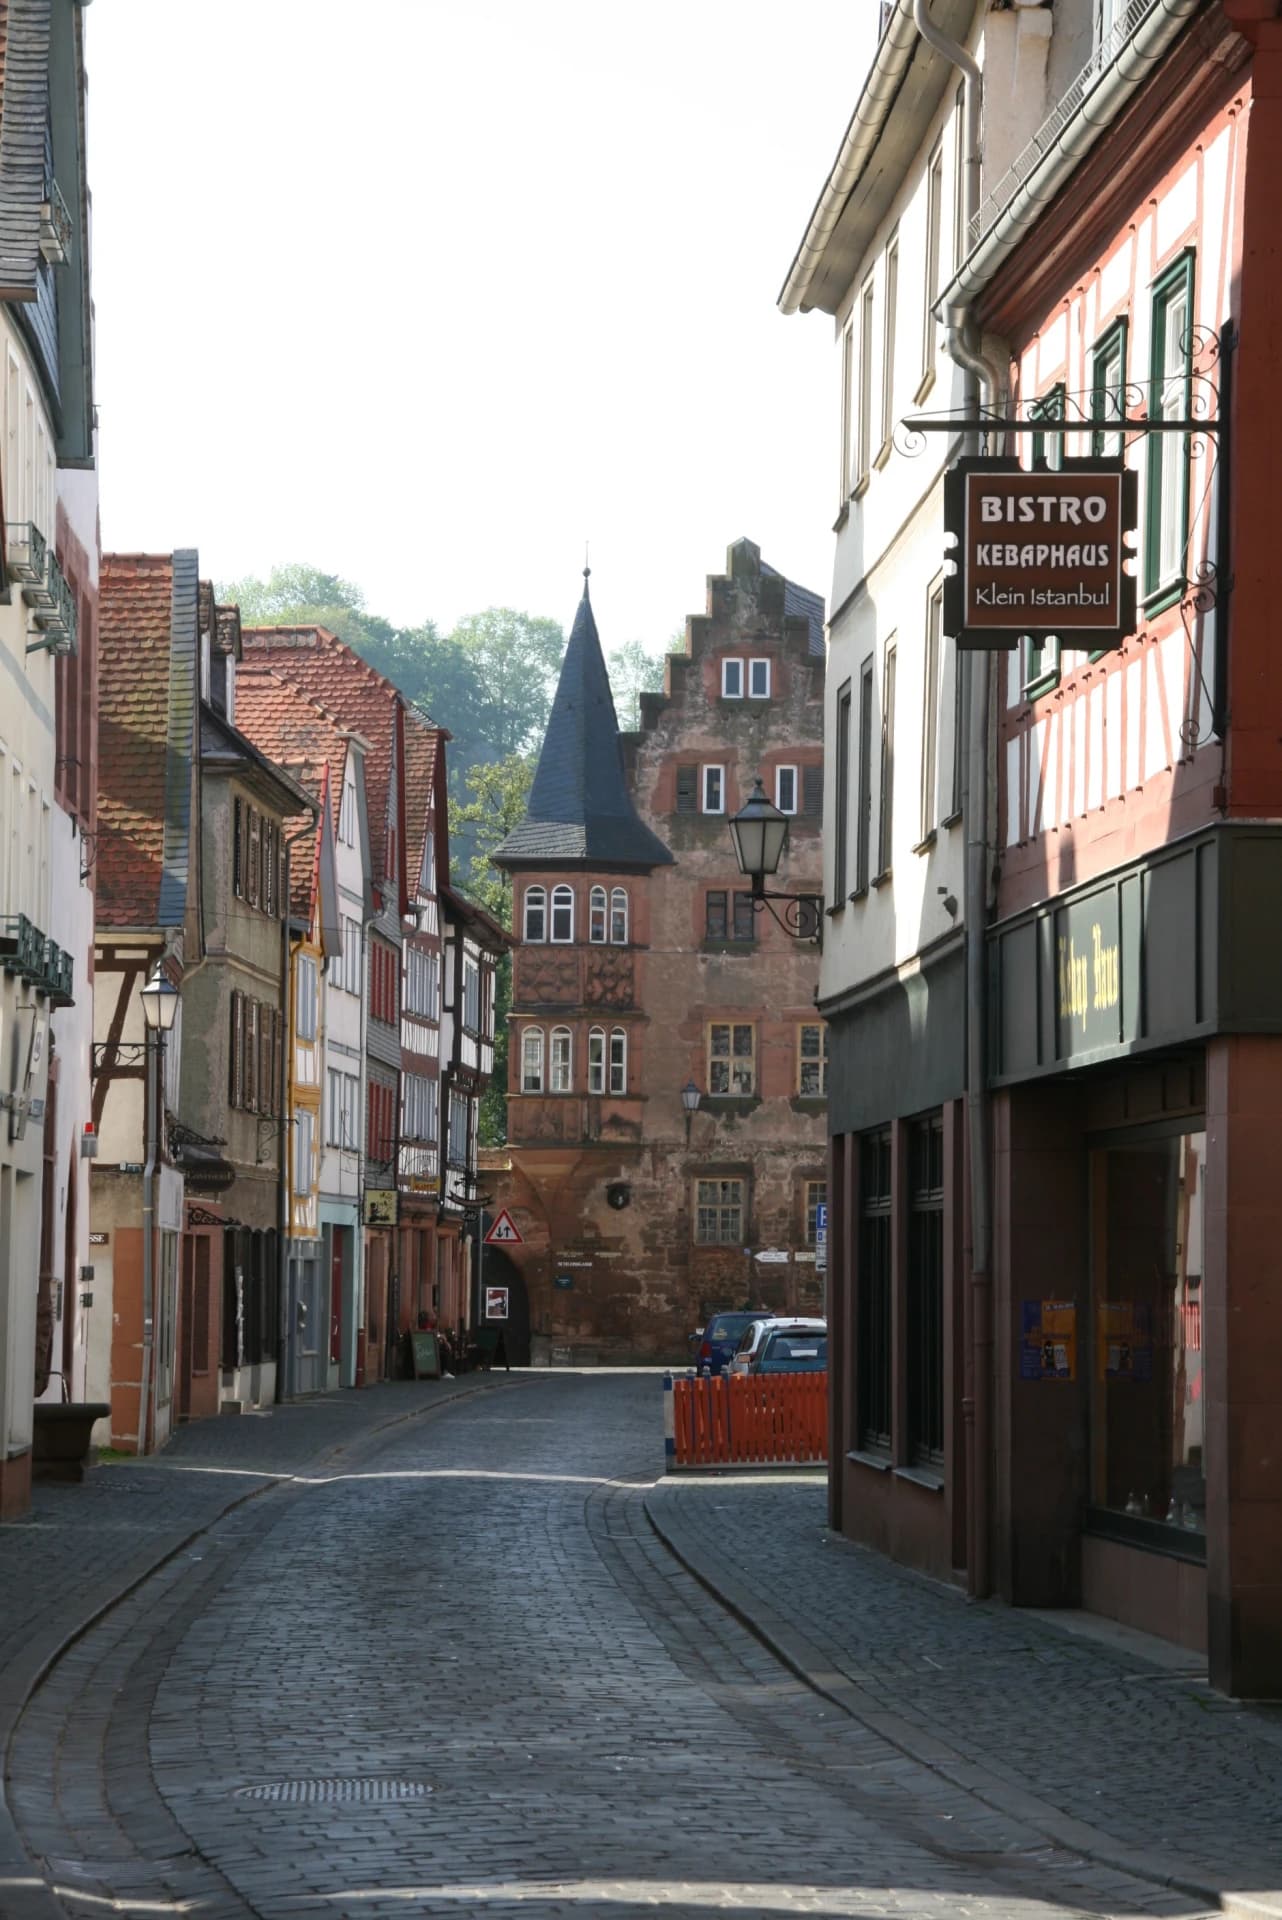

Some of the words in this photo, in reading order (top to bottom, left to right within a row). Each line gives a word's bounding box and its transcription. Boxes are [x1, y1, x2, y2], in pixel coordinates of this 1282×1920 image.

[981, 496, 1107, 525] BISTRO
[977, 544, 1109, 568] KEBAPHAUS
[976, 582, 1024, 606] Klein
[1031, 582, 1109, 606] Istanbul
